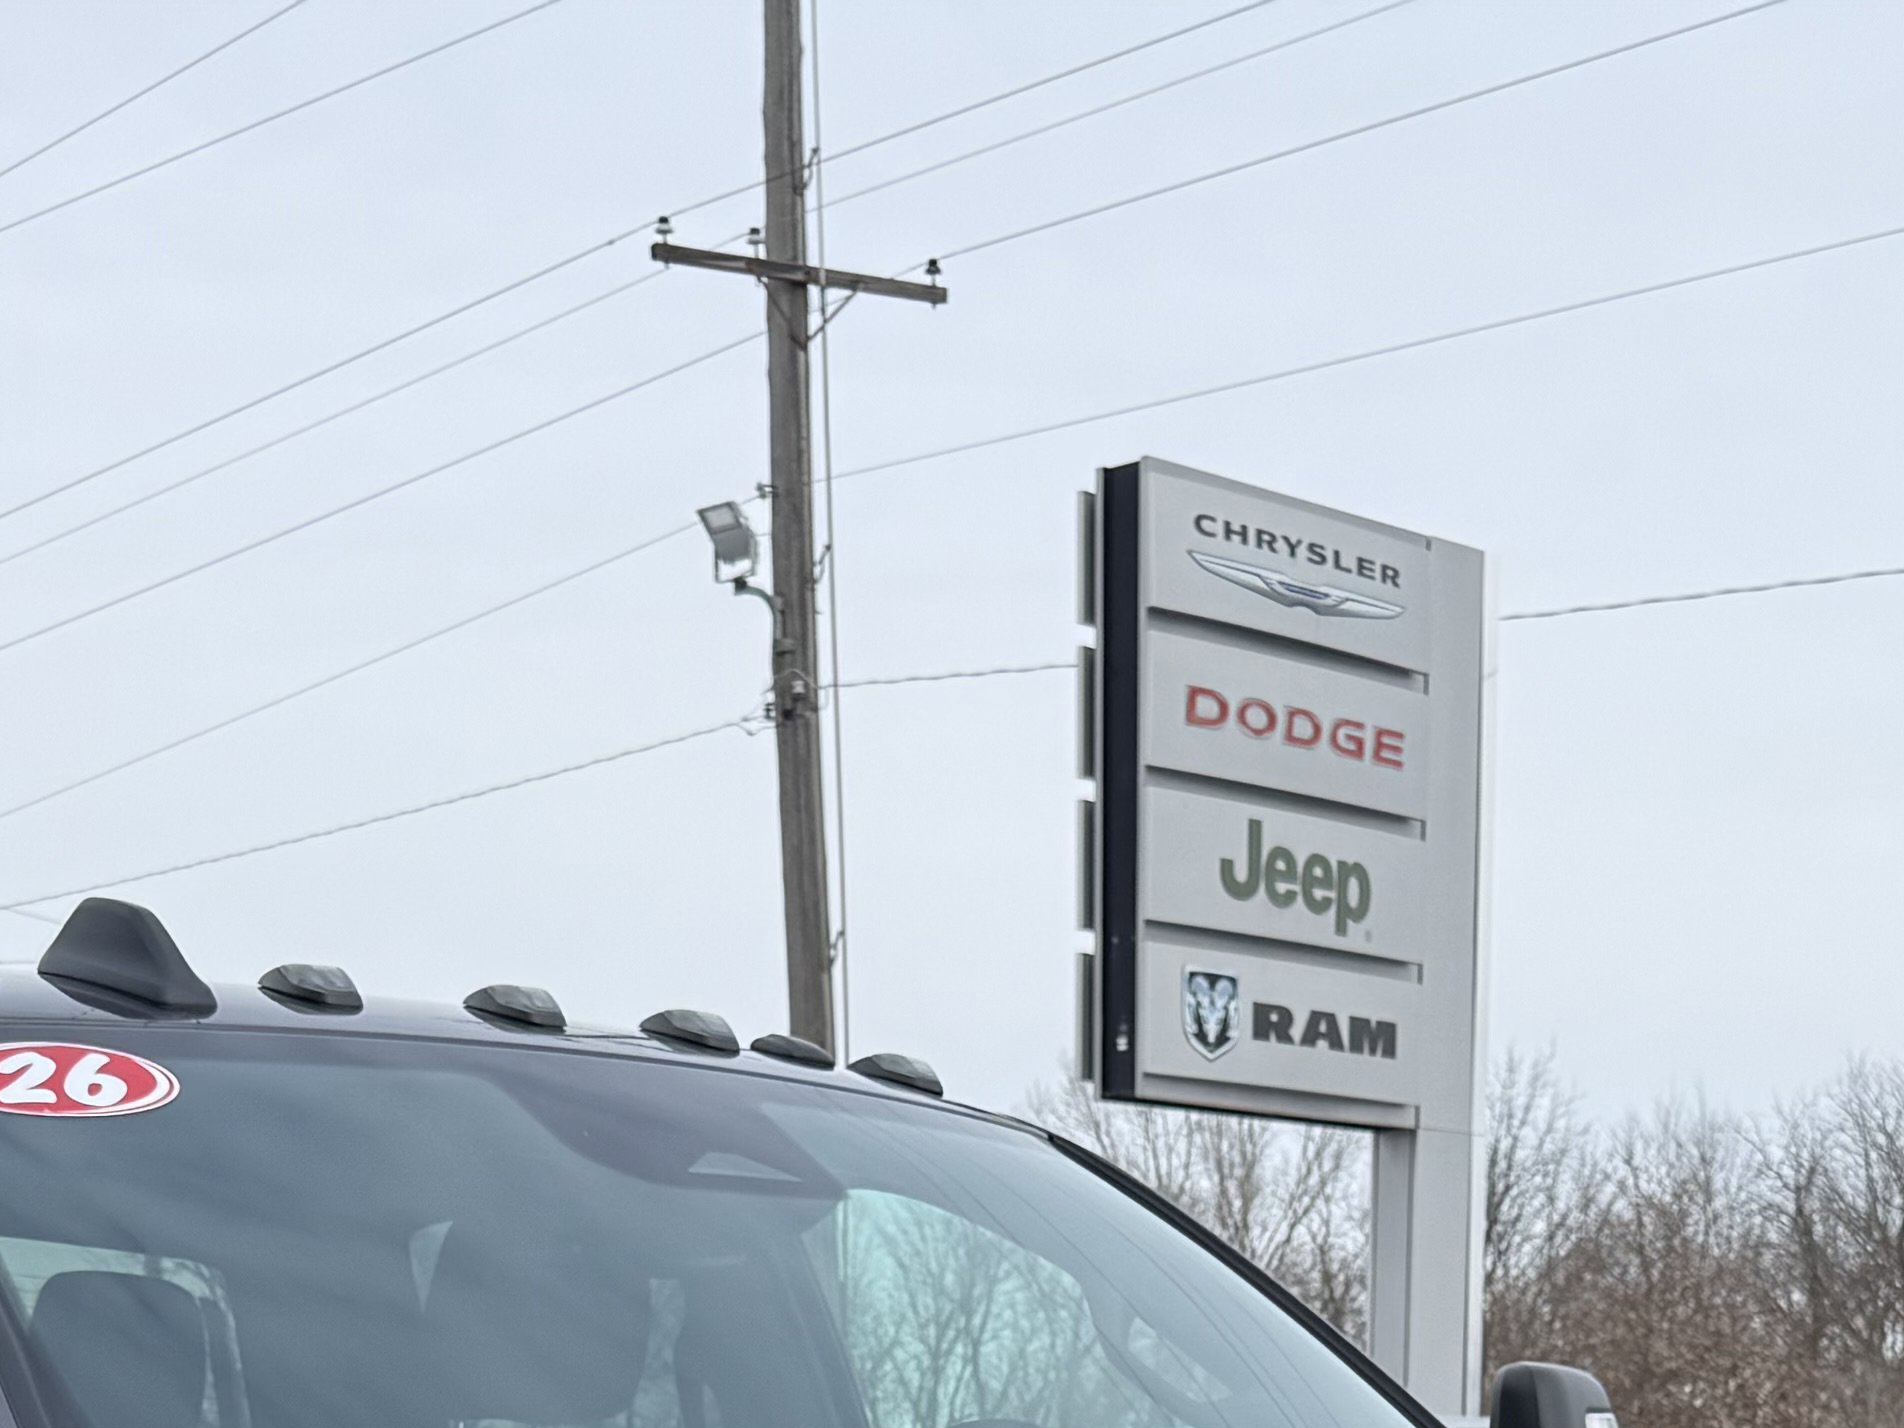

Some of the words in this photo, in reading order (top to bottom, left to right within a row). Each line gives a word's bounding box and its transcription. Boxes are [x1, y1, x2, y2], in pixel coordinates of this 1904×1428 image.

[1193, 513, 1402, 588] CHRYSLER
[1184, 684, 1405, 769] DODGE
[1219, 818, 1371, 936] Jeep
[1252, 1001, 1397, 1060] RAM
